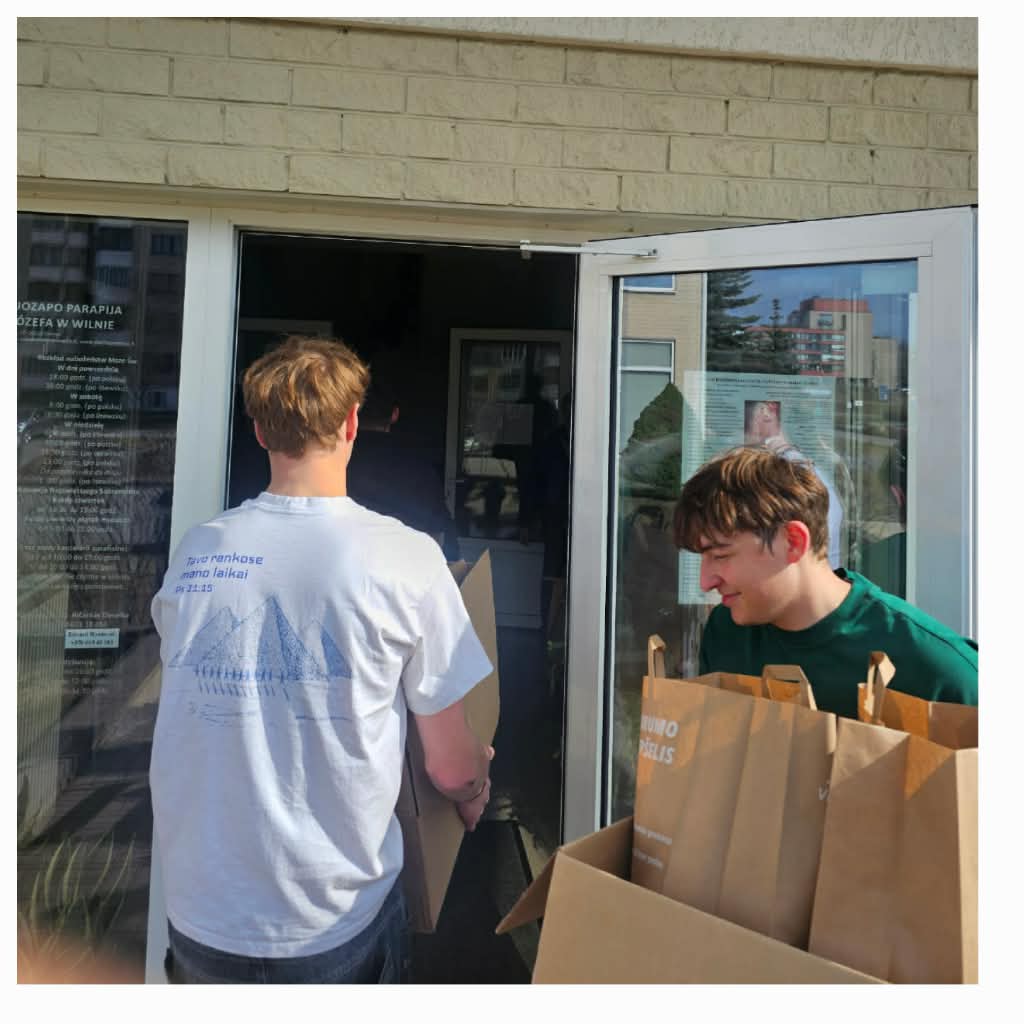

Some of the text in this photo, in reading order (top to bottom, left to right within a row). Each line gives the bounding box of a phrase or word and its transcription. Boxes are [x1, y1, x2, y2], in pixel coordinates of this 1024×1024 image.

[66, 303, 123, 315] PARAPIJA
[57, 318, 69, 329] W
[72, 318, 115, 330] WILNIE
[187, 552, 264, 566] Tavo rankose
[180, 567, 248, 580] mano laikai
